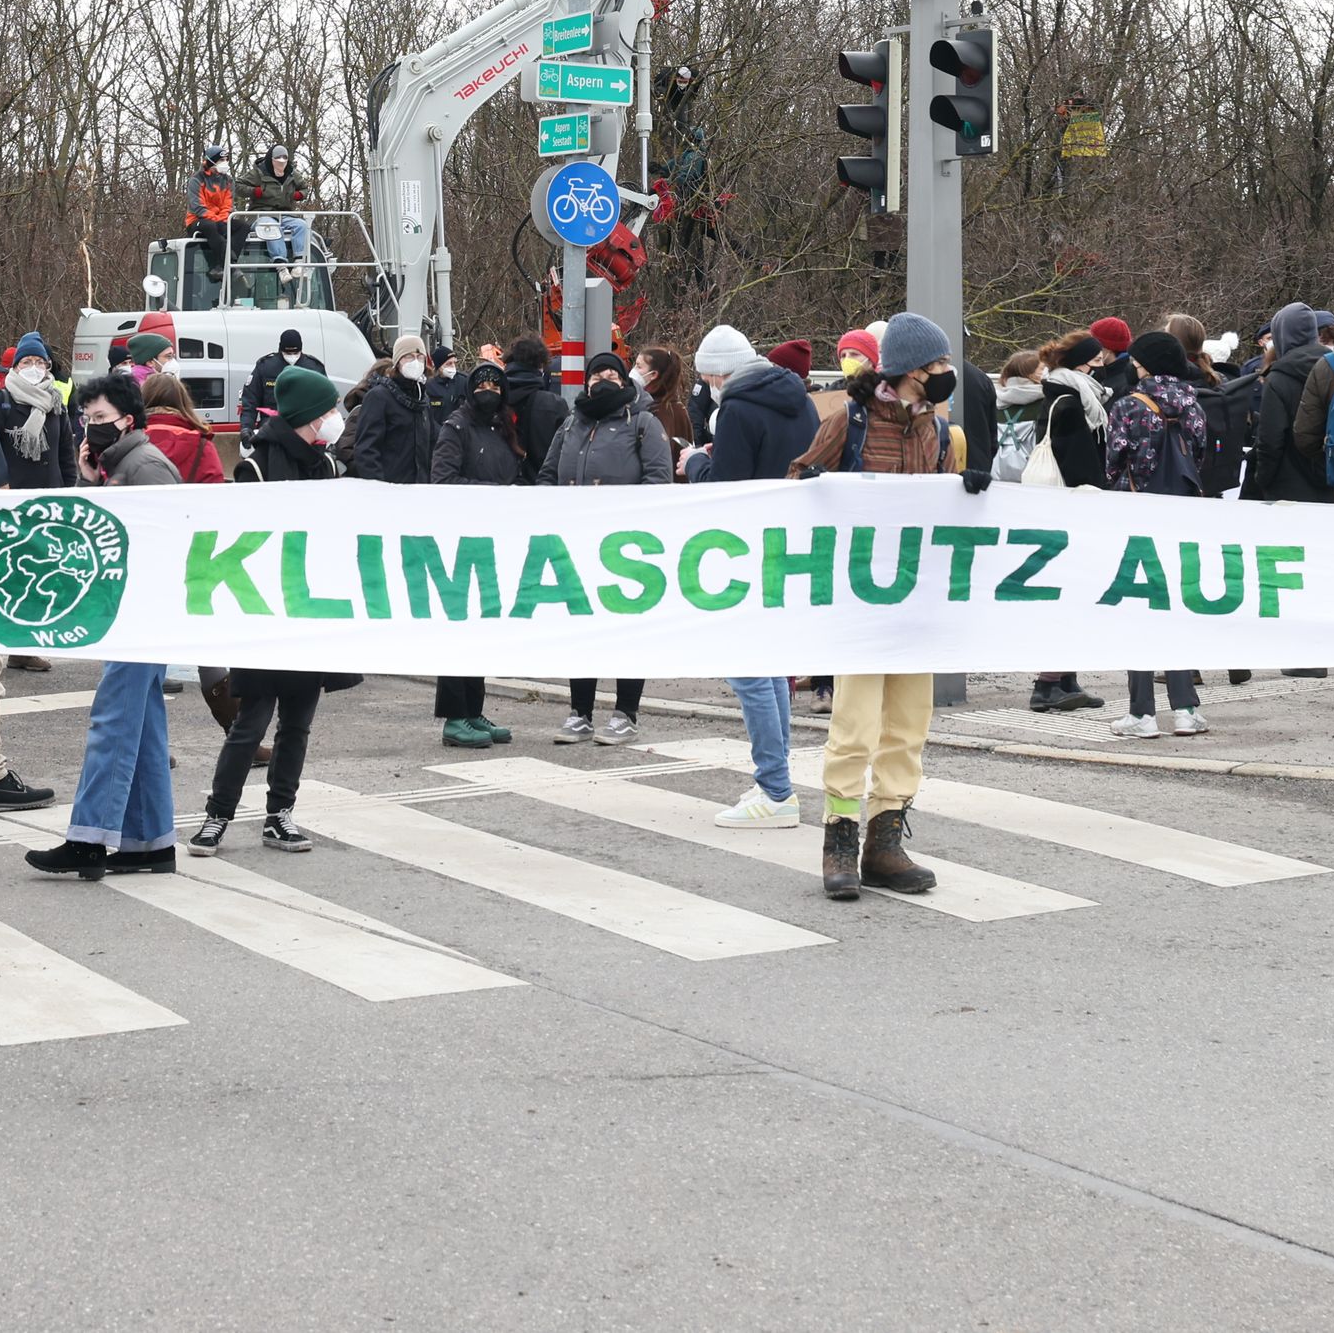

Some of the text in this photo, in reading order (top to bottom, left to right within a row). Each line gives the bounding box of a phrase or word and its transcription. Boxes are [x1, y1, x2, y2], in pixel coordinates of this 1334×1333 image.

[567, 73, 603, 90] Aspern
[71, 503, 124, 581] FUTURE
[185, 526, 1069, 621] KLIMASCHUTZ
[1095, 535, 1305, 618] AUF
[30, 625, 89, 647] Wien
